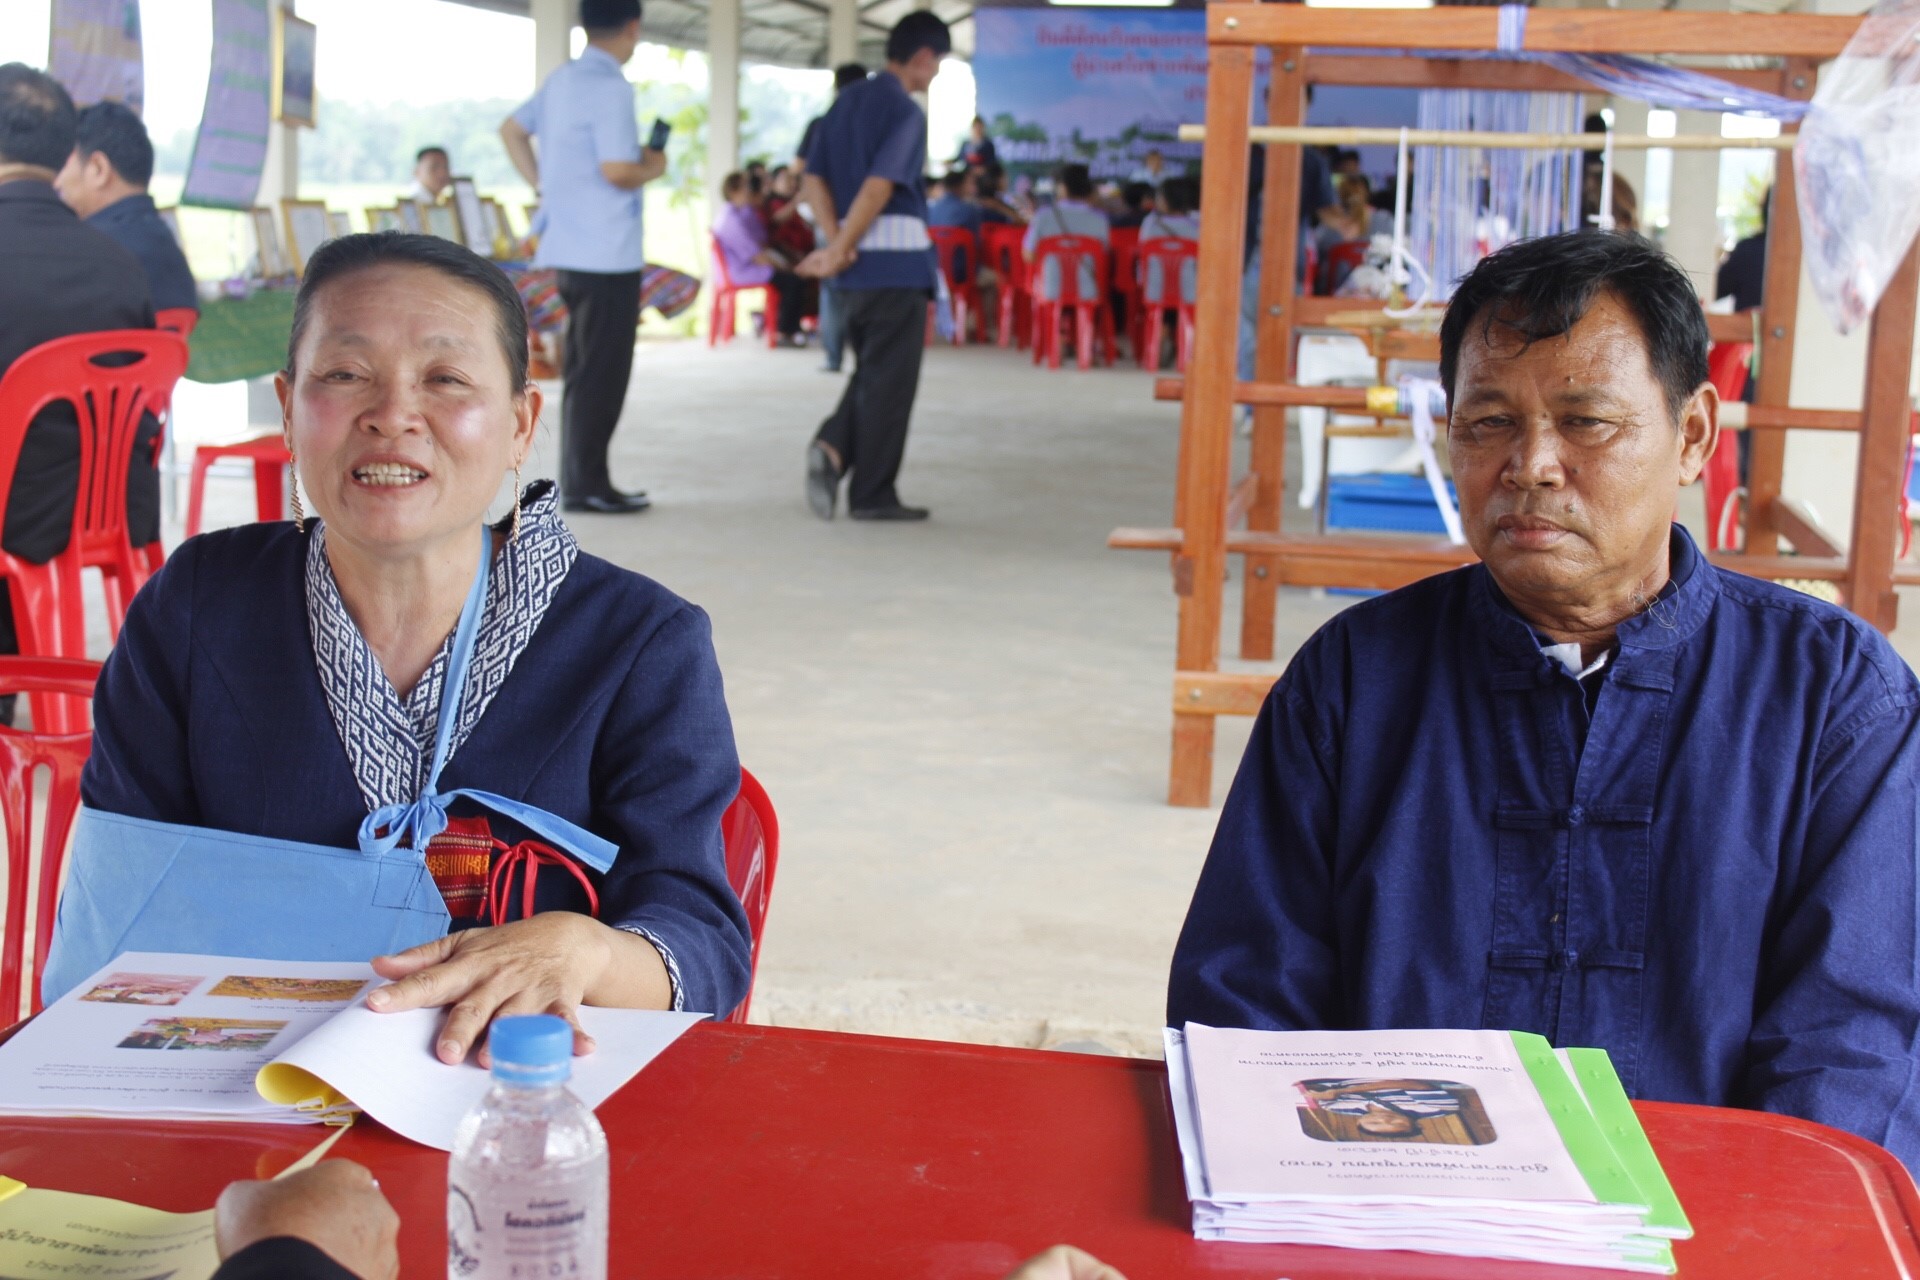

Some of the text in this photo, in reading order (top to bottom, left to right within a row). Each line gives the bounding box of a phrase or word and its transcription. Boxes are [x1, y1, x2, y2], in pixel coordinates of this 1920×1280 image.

[1341, 1159, 1548, 1173] ผู้นำอาสาพัฒนาชุมชน
